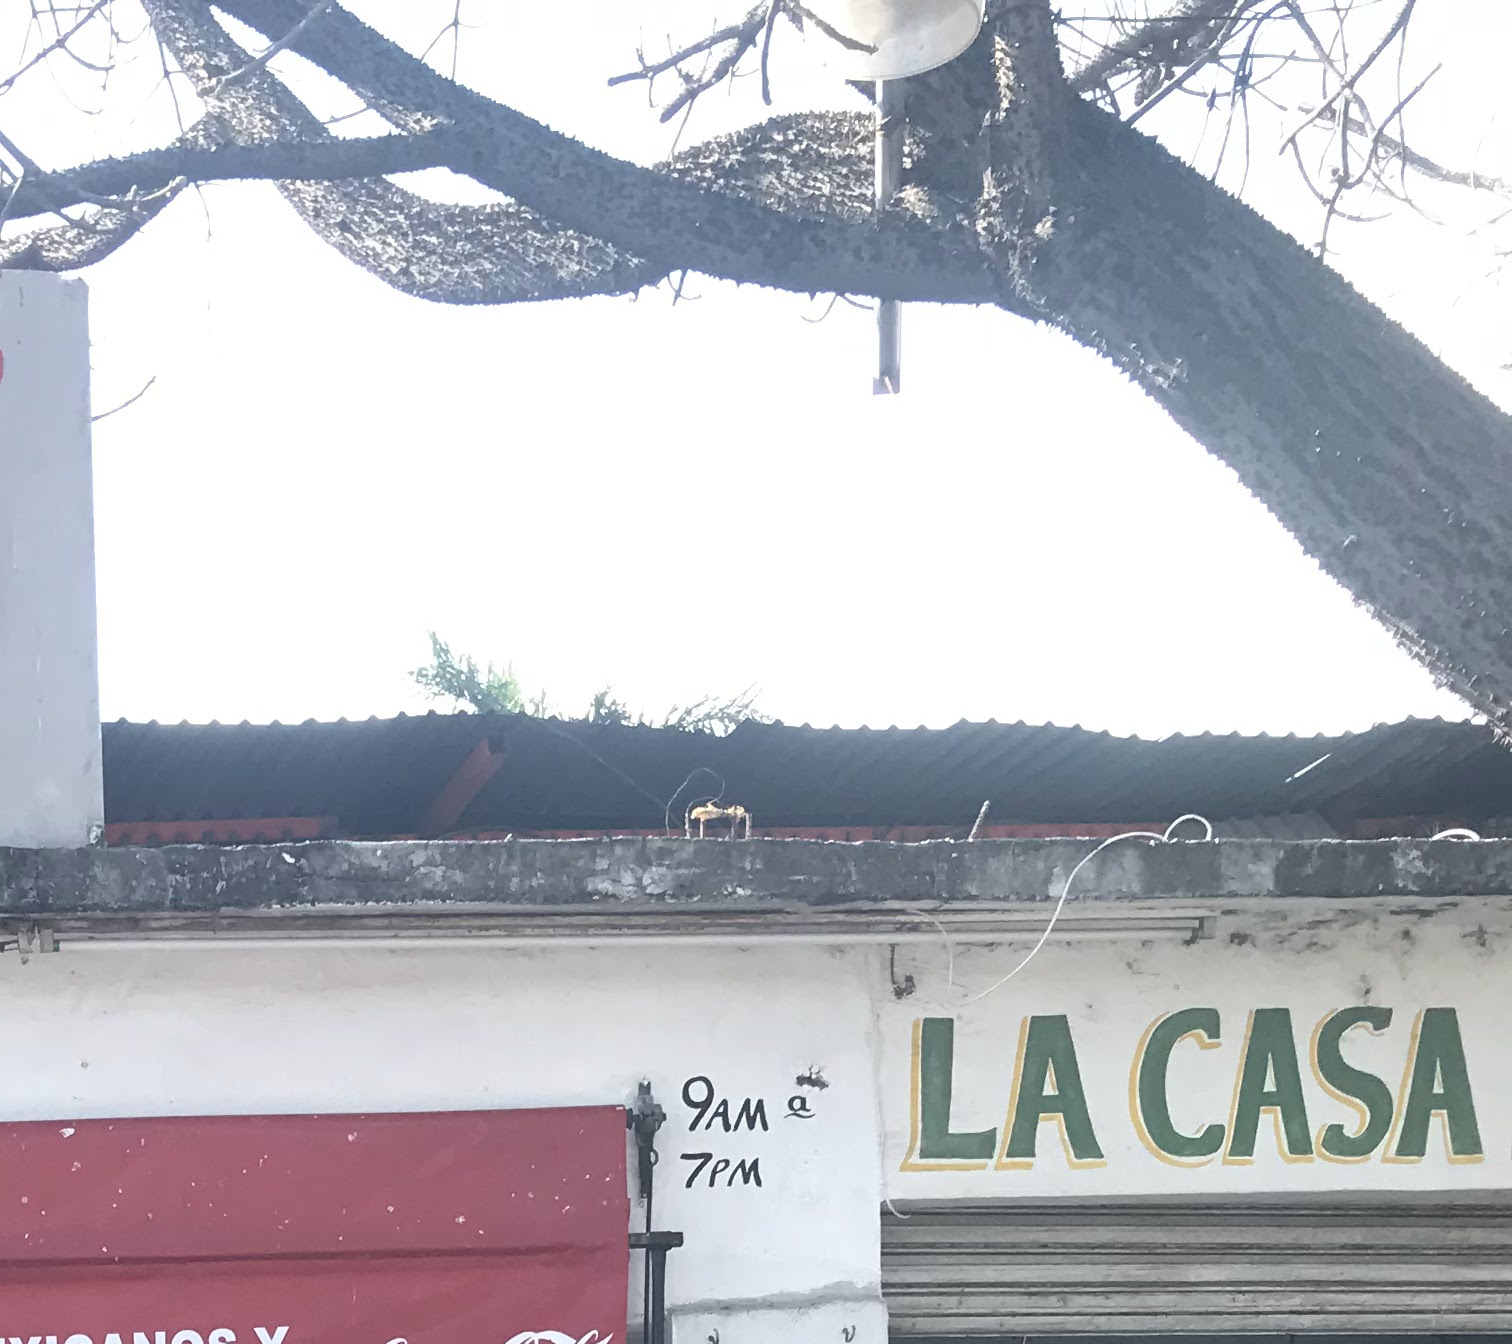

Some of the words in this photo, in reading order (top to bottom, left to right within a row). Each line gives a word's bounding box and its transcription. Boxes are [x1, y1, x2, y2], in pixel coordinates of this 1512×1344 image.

[681, 1076, 770, 1133] 9AM
[900, 1012, 1106, 1172] LA
[1128, 1006, 1485, 1169] CASA
[679, 1152, 763, 1188] 7PM
